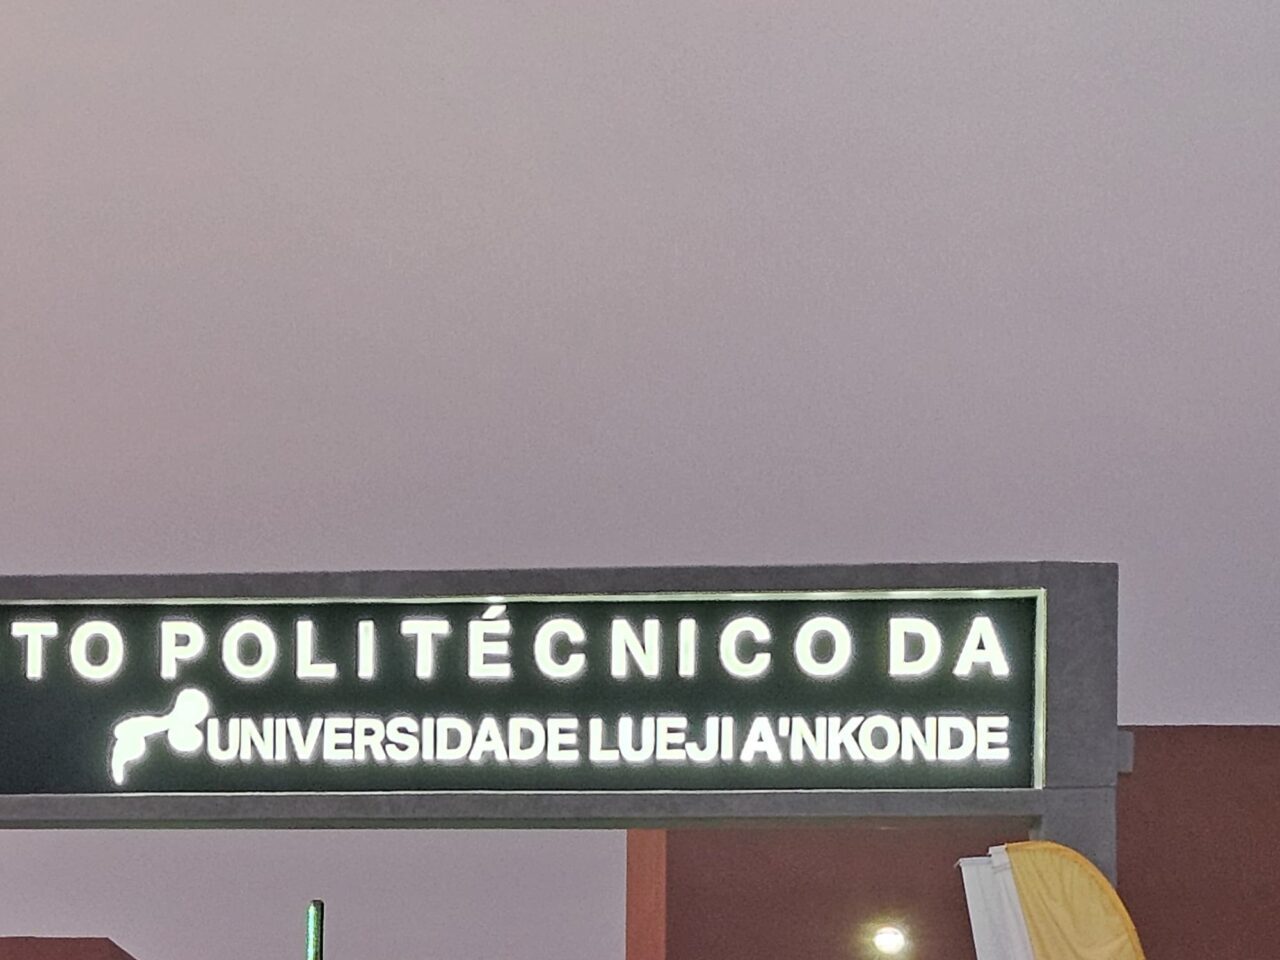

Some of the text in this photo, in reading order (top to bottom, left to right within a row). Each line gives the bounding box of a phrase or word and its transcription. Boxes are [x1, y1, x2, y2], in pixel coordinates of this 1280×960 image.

[161, 605, 853, 682] POLITÉCNICO
[889, 617, 1010, 678] DA
[207, 714, 1011, 764] UNIVERSIDADE LUEJI A'NKONDE
